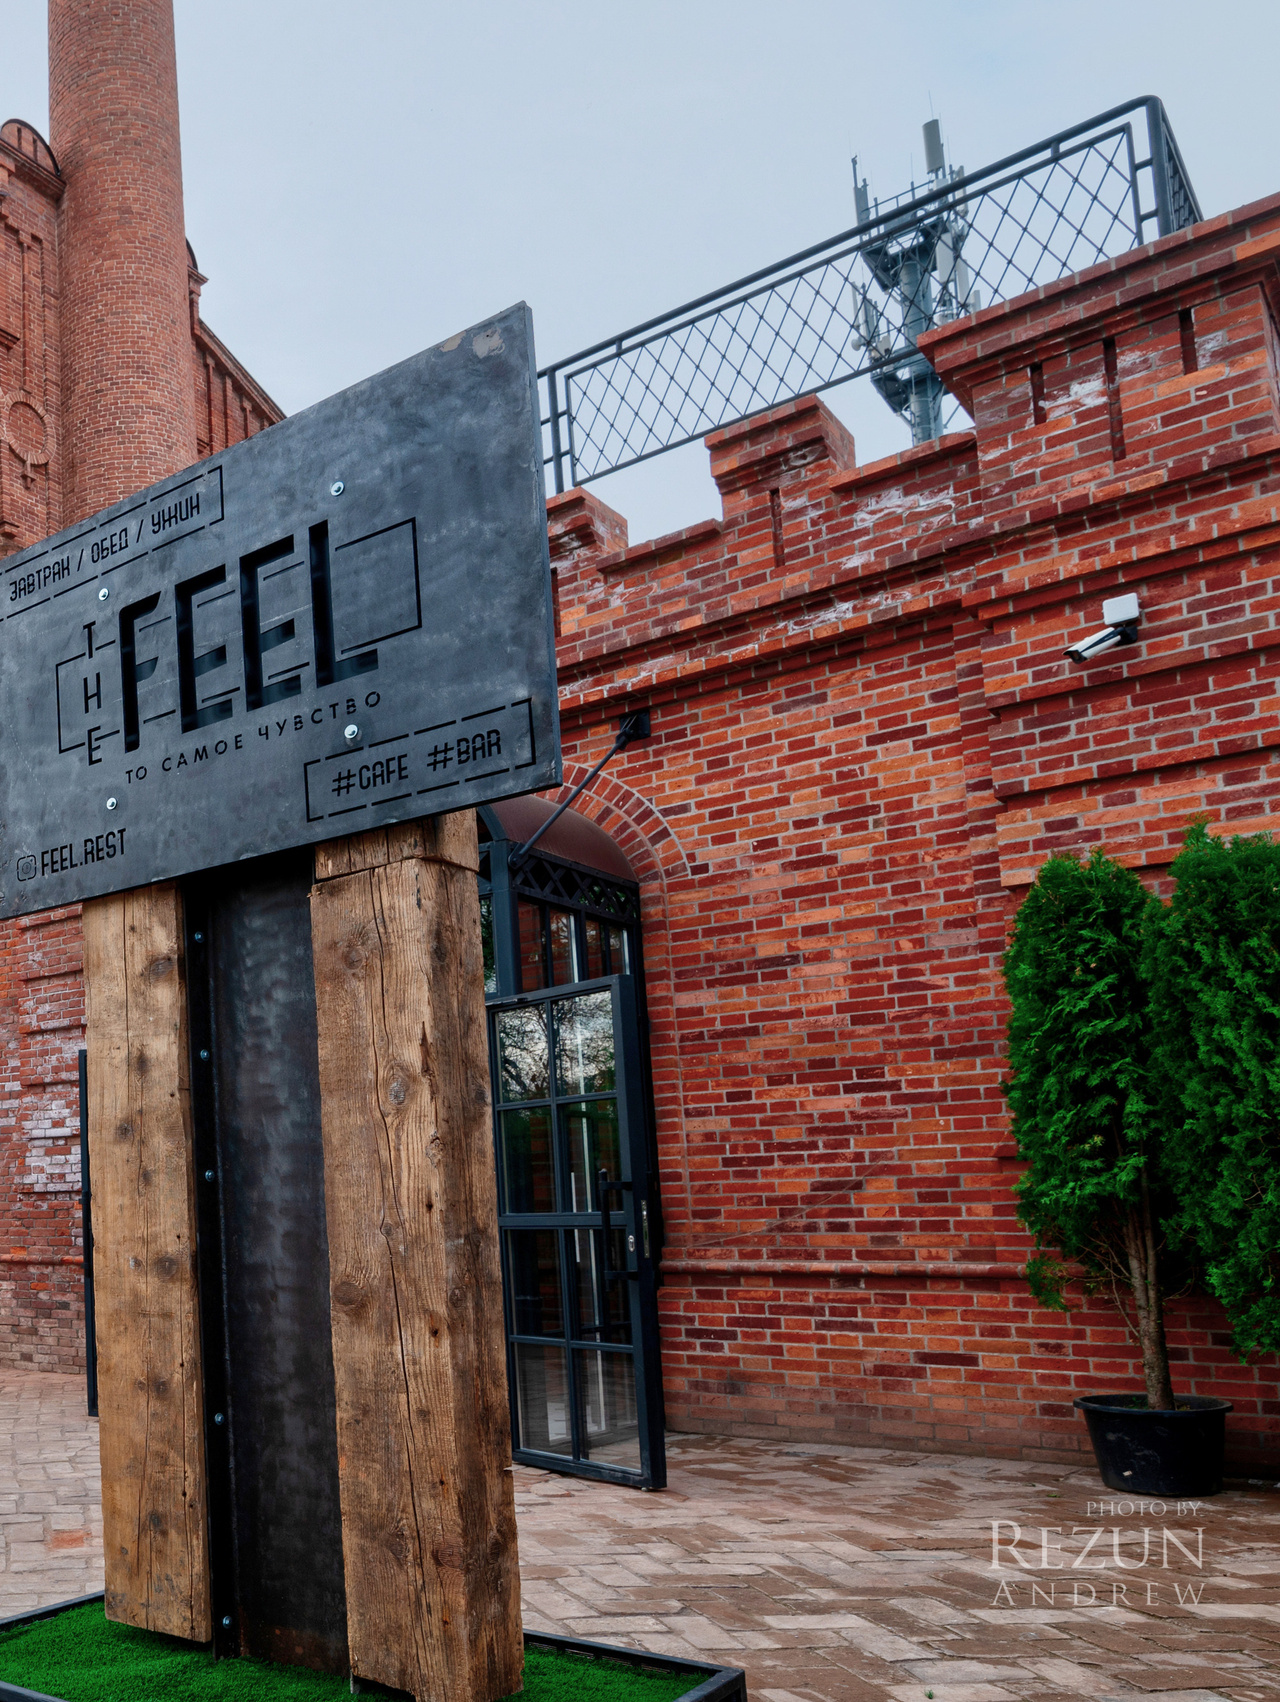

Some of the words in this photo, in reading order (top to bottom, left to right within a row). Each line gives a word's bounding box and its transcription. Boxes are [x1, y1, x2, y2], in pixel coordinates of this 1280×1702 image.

[8, 555, 70, 602] ЗАВТРАК
[91, 527, 129, 564] ОБЕД
[151, 493, 201, 534] УЖИН
[119, 519, 379, 753] FEEL
[82, 620, 102, 766] THE
[125, 765, 148, 784] ТО
[161, 734, 243, 772] САМОЕ
[258, 691, 381, 740] ЧУВСТВО
[331, 753, 409, 797] #CAFE
[427, 728, 502, 772] #BAR
[41, 828, 126, 876] FEEL.REST
